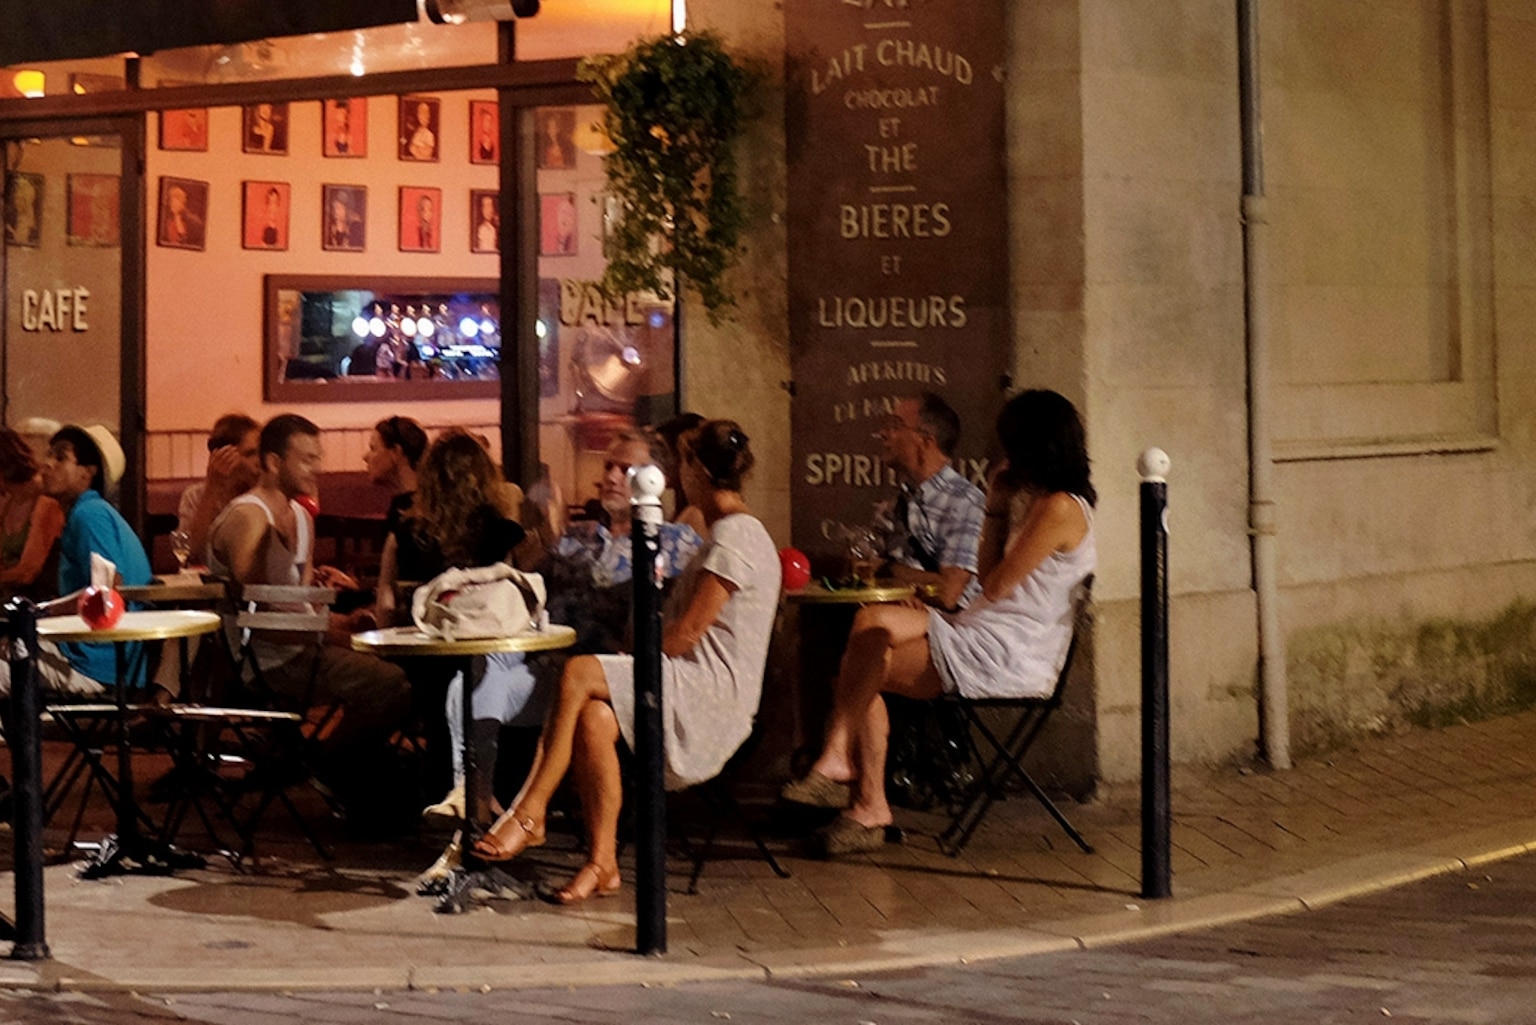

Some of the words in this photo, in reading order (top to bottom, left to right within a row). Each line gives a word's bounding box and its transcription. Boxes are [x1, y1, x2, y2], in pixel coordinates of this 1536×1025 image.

[811, 43, 867, 95] LAIT
[876, 39, 973, 85] CHAUD
[844, 85, 939, 111] CHOCOLAT
[879, 118, 901, 138] ET
[865, 144, 917, 174] THE
[840, 203, 952, 240] BIERES
[880, 255, 902, 276] ET
[818, 295, 968, 329] LIQUEURS
